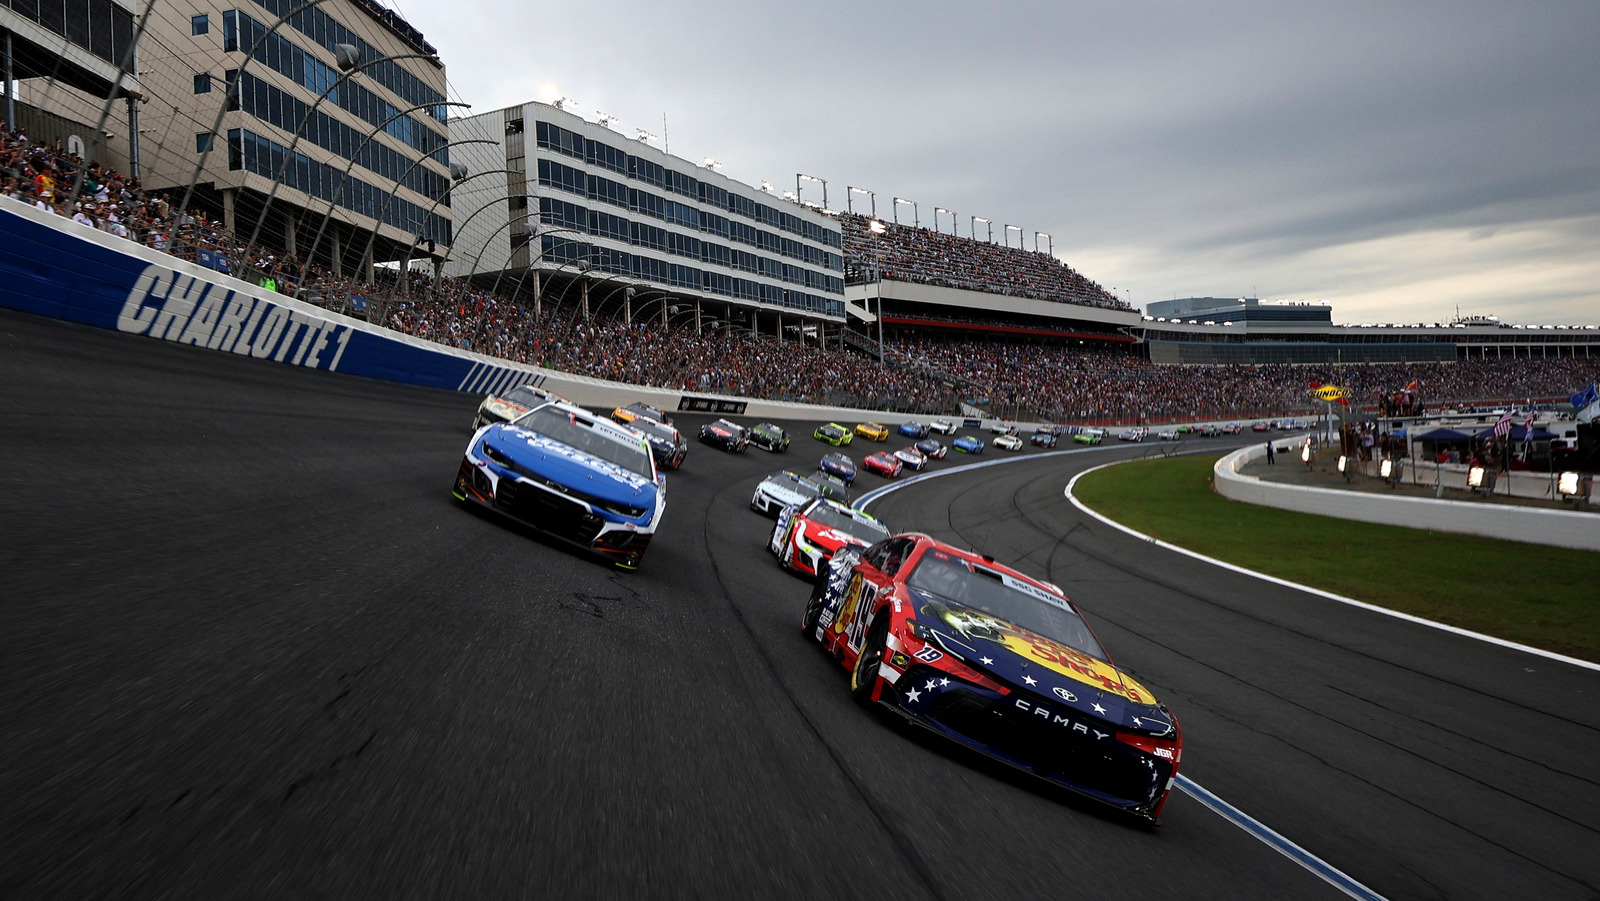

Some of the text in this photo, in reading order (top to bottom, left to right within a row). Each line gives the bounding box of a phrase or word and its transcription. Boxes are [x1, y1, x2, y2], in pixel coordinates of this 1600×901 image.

[117, 264, 337, 368] CHARLOTTE
[1308, 389, 1350, 398] SUNOCO
[914, 645, 943, 663] 19
[1031, 643, 1143, 702] Shops
[1015, 698, 1110, 740] CAMRY
[1153, 747, 1174, 760] JGR
